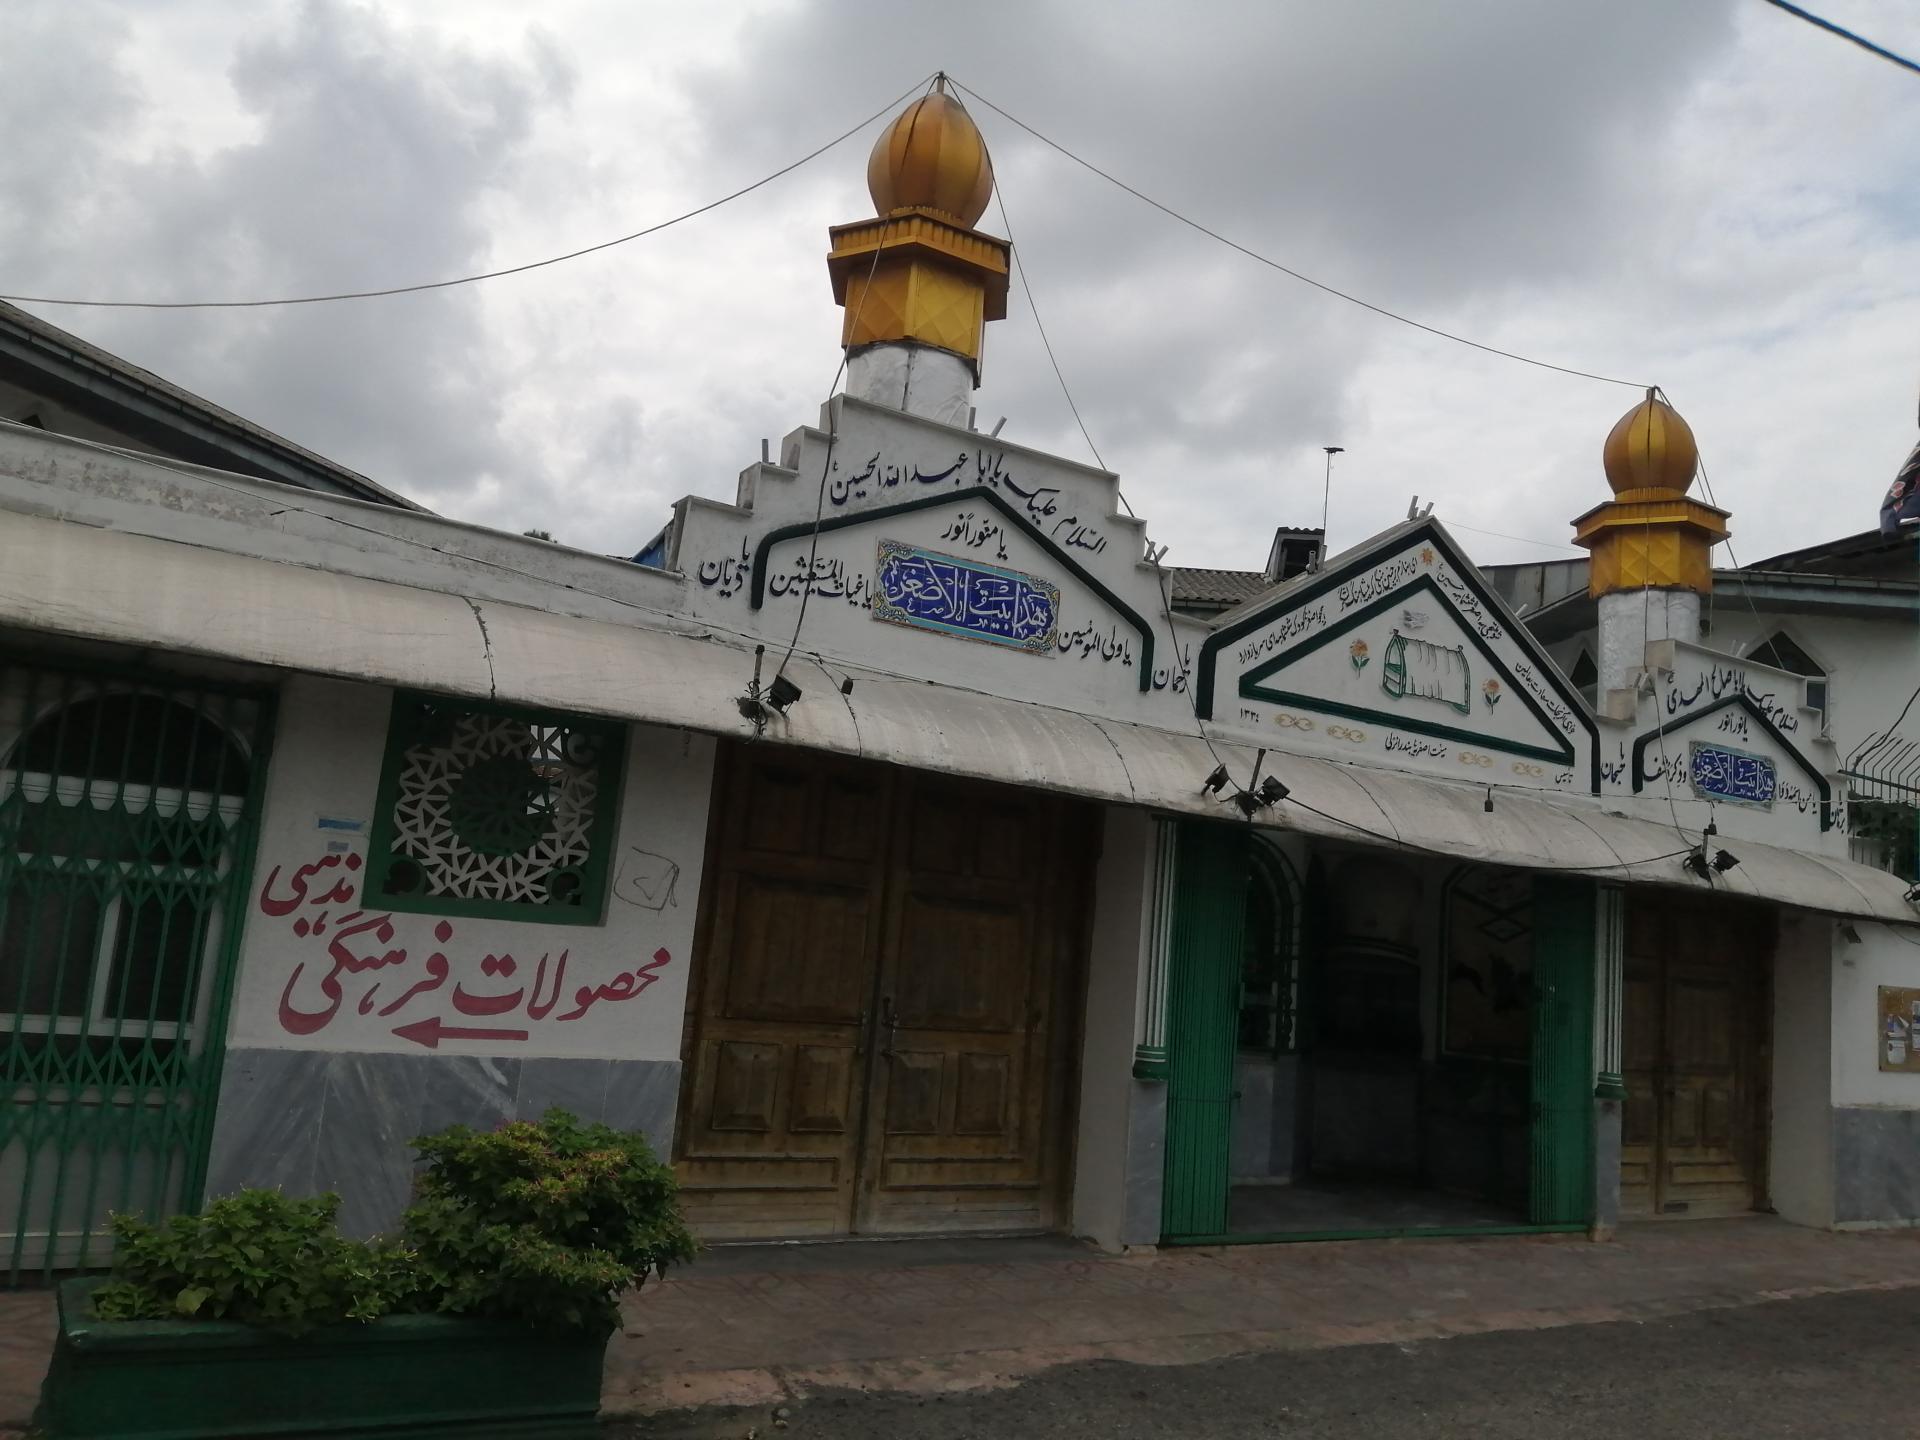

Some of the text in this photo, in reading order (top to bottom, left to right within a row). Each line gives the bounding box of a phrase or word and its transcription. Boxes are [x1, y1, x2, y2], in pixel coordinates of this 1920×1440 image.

[1003, 471, 1060, 525] علیک
[996, 528, 1008, 560] یا
[862, 579, 872, 610] یا
[1122, 638, 1132, 666] یا
[260, 852, 362, 936] مذهبی
[278, 912, 671, 1035] محصولات فرهنگی
